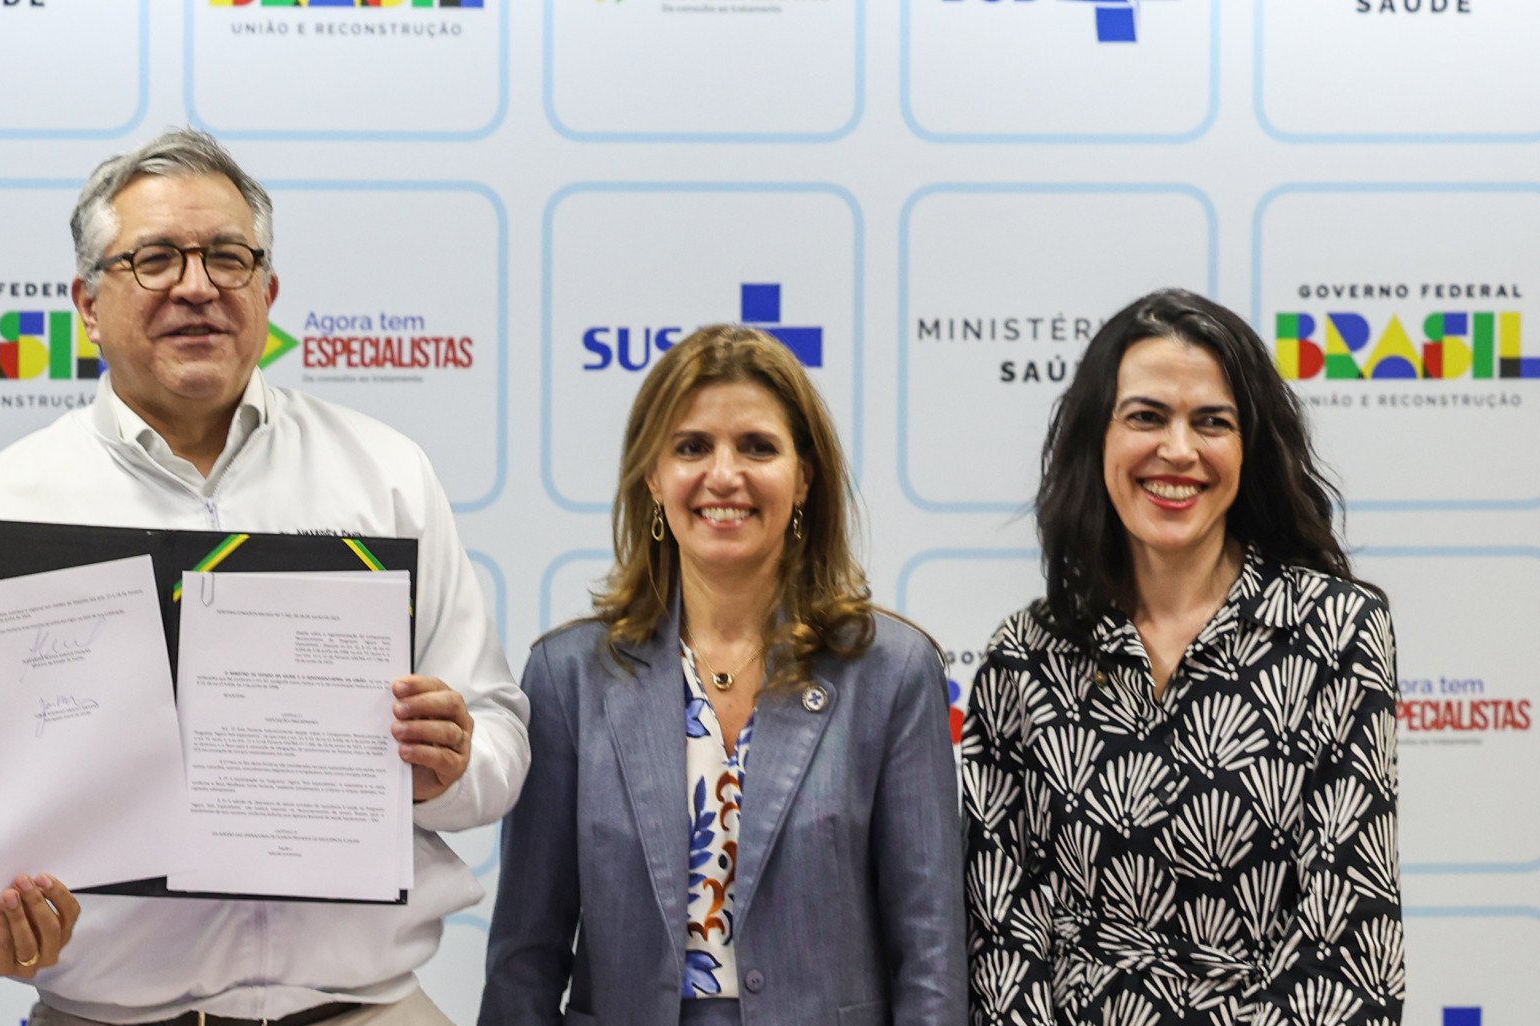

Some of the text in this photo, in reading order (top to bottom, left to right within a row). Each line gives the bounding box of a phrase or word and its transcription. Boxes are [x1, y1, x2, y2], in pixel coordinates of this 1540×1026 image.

[231, 21, 463, 38] UNIÃO E RECONSTRUÇÃO
[1298, 285, 1523, 299] GOVERNO FEDERAL
[304, 311, 425, 334] Agora tem
[918, 312, 1105, 341] MINISTÉR
[303, 336, 473, 368] ESPECIALISTAS
[1276, 311, 1540, 380] BRASIL
[1000, 354, 1080, 383] SAÚ
[1303, 393, 1523, 411] NIÃO E RECONSTRUÇÃO
[1440, 676, 1485, 694] tem
[1395, 698, 1532, 731] PECIALISTAS
